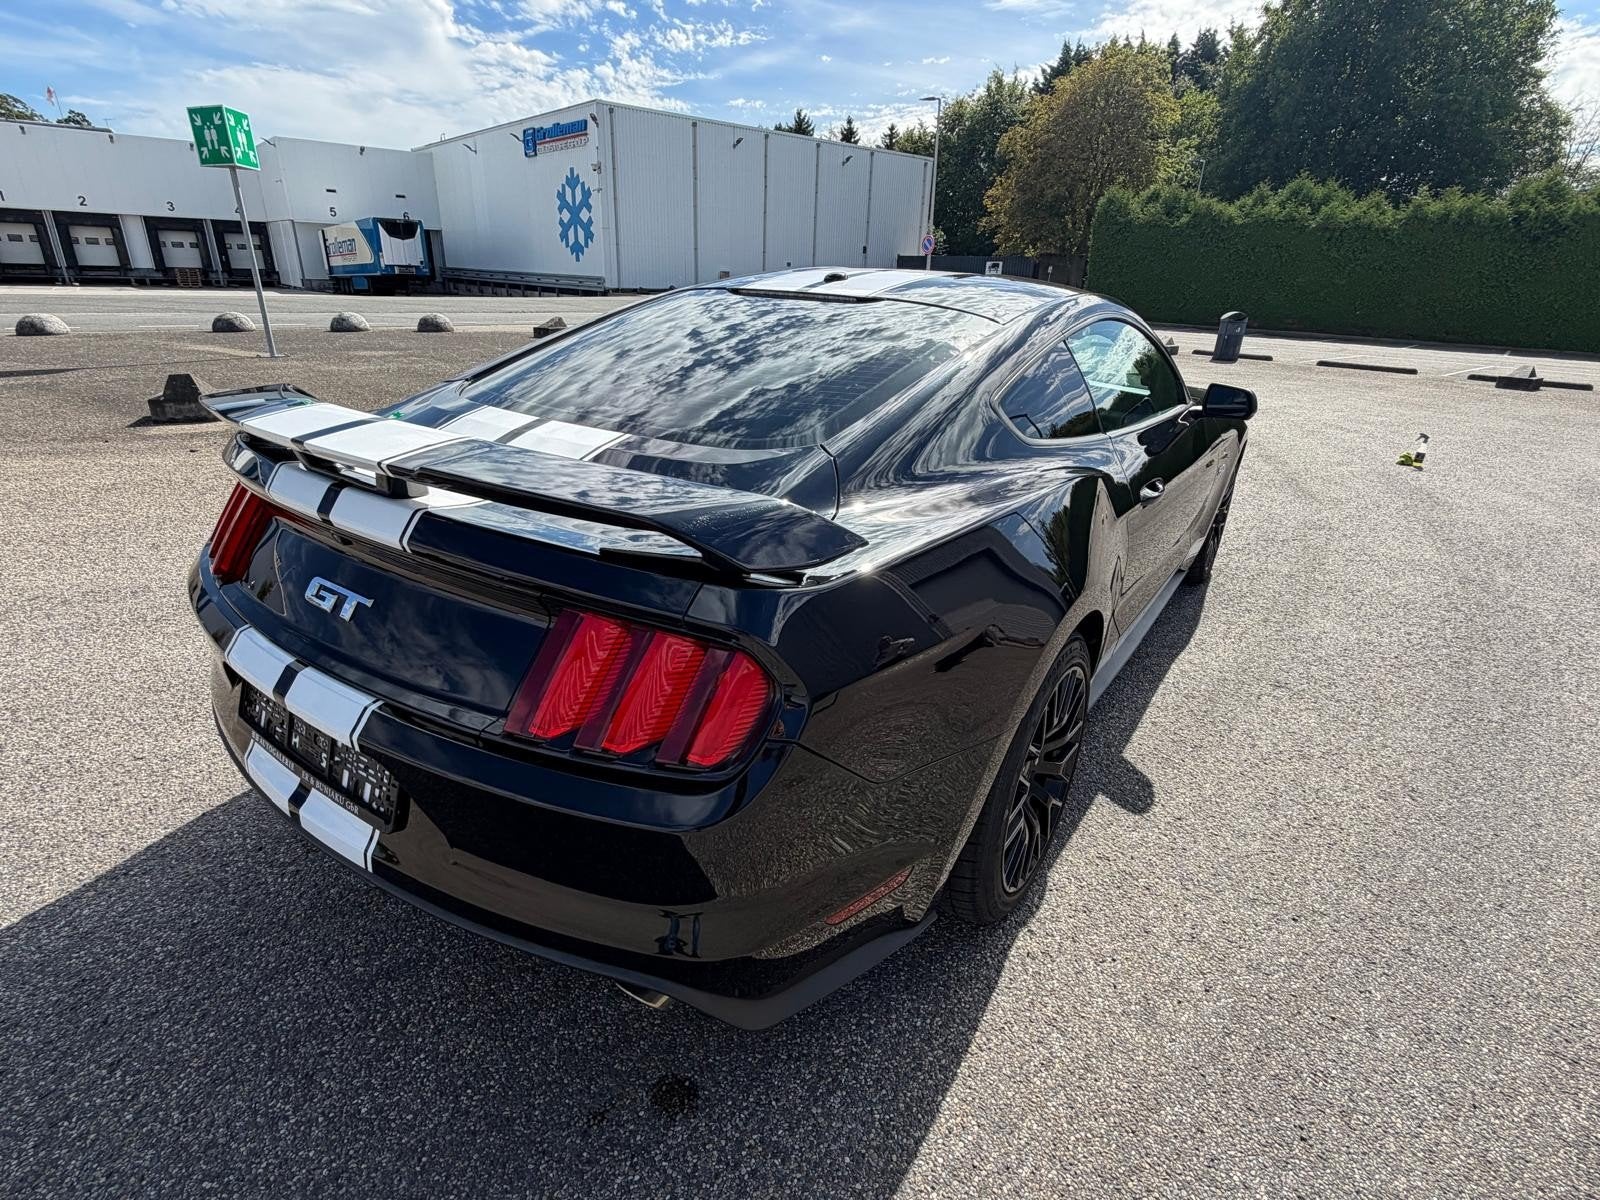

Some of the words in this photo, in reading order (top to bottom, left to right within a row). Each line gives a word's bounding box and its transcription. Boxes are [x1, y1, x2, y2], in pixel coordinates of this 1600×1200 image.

[536, 119, 588, 141] Grolleman
[77, 195, 88, 207] 2
[166, 201, 176, 212] 3
[329, 207, 337, 217] 5
[403, 211, 410, 221] 6
[304, 576, 375, 622] GT
[345, 800, 359, 815] GbR
